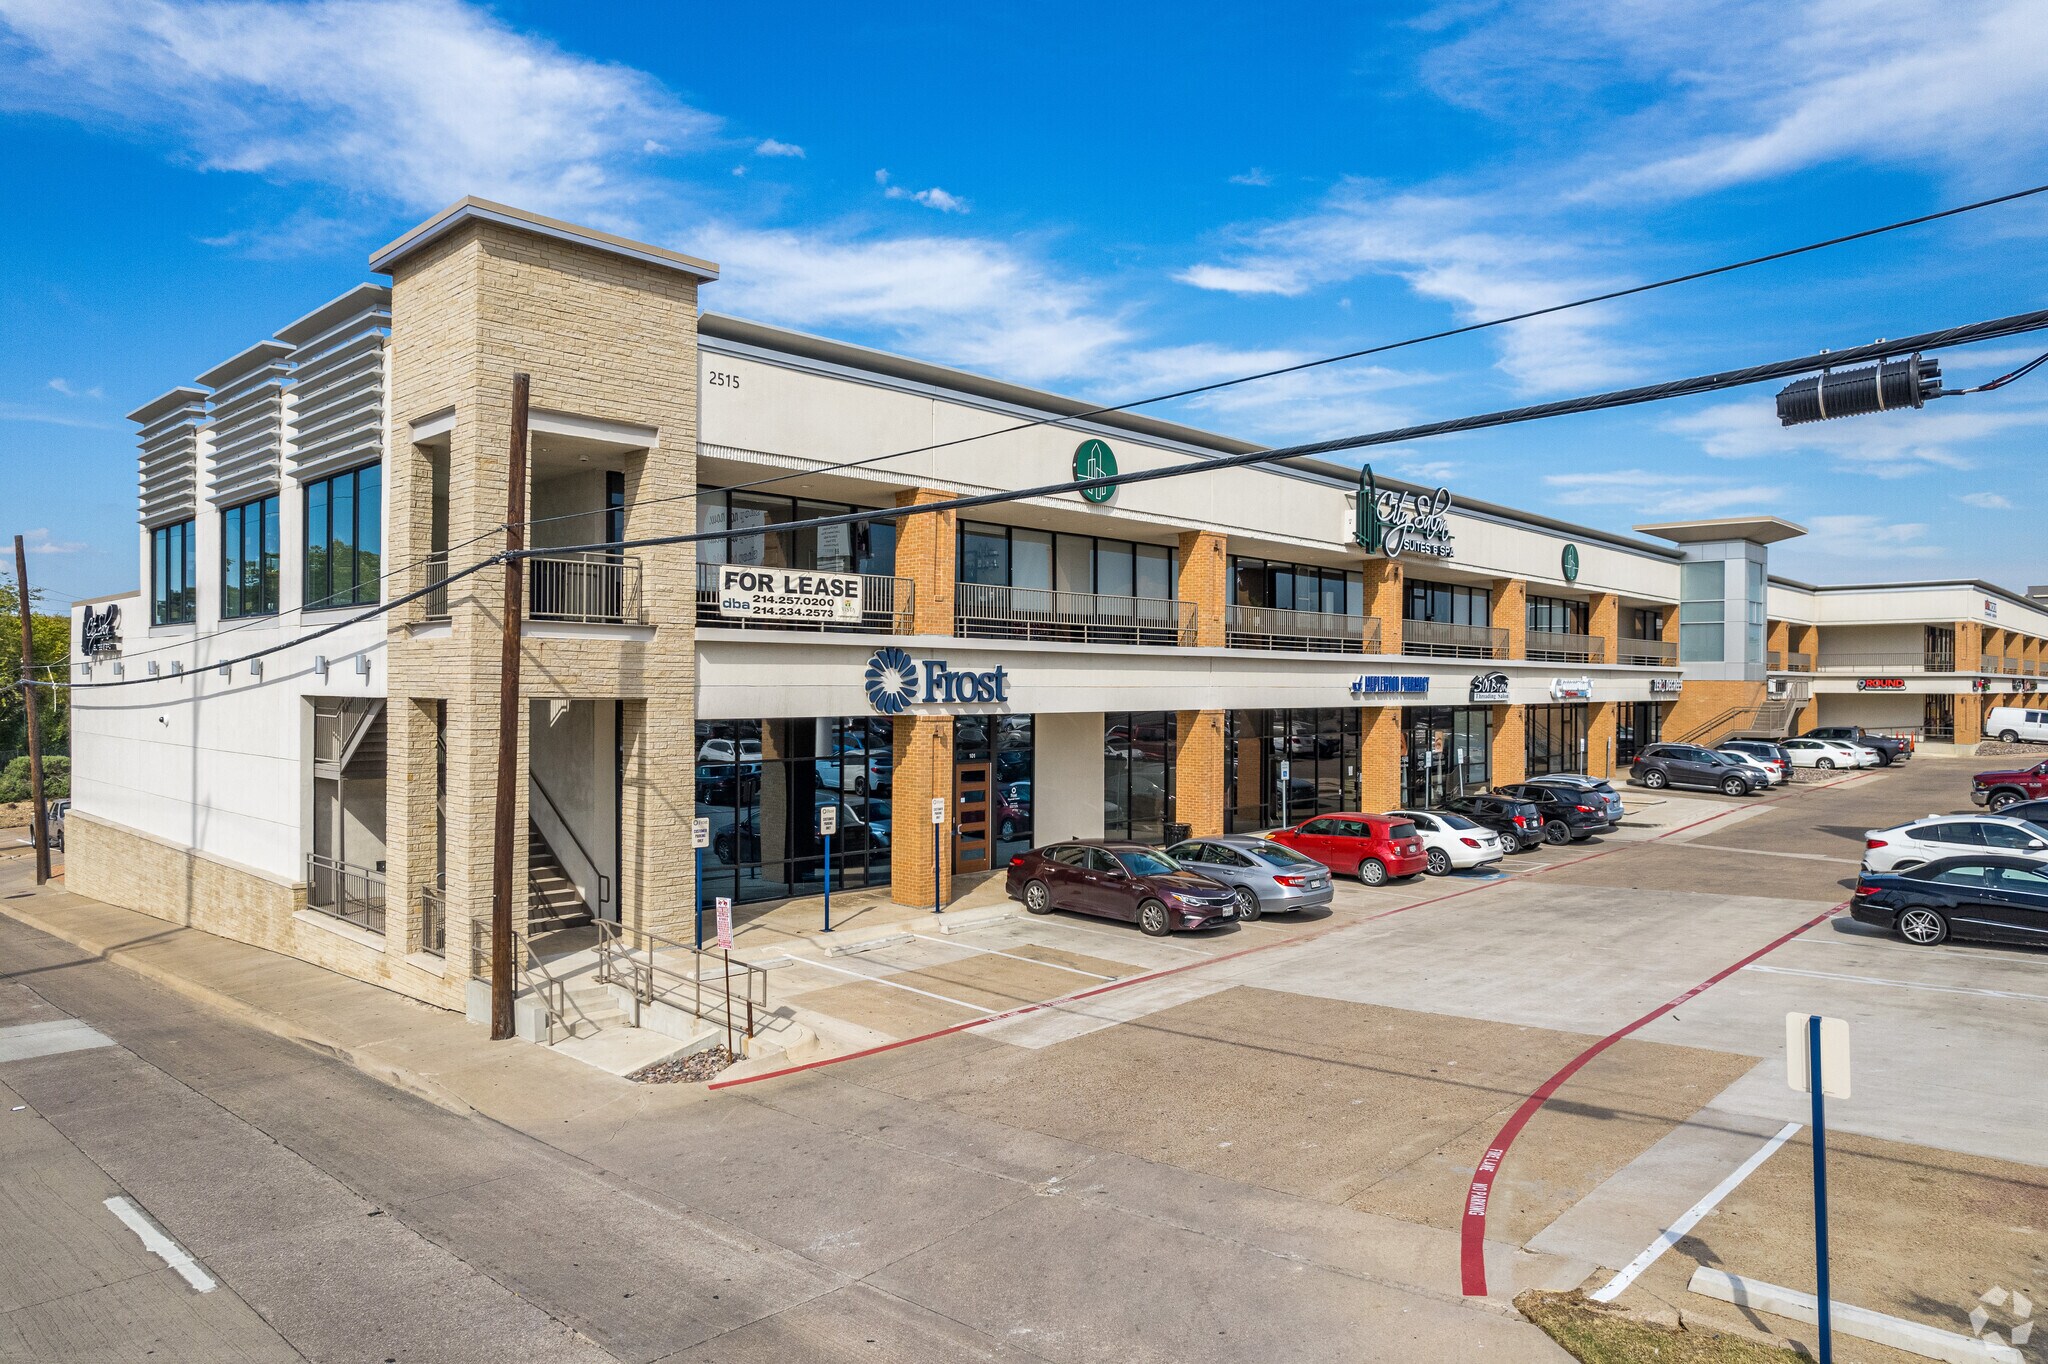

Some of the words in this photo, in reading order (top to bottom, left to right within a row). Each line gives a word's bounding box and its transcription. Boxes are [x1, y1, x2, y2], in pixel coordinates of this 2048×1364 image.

[709, 371, 740, 389] 2515
[1376, 491, 1415, 557] City
[1414, 487, 1452, 541] Salon
[1403, 540, 1431, 554] SUITES
[1440, 546, 1455, 557] SPA
[725, 571, 775, 593] FOR
[784, 576, 859, 598] LEASE
[723, 598, 750, 609] dba
[752, 595, 835, 607] 214.257.0200
[752, 606, 834, 617] 214.234.2573
[922, 661, 1009, 703] Frost
[1486, 1148, 1503, 1159] FIRE
[1479, 1159, 1498, 1172] LANE
[1472, 1183, 1488, 1191] NO
[1468, 1191, 1487, 1216] PARKING
